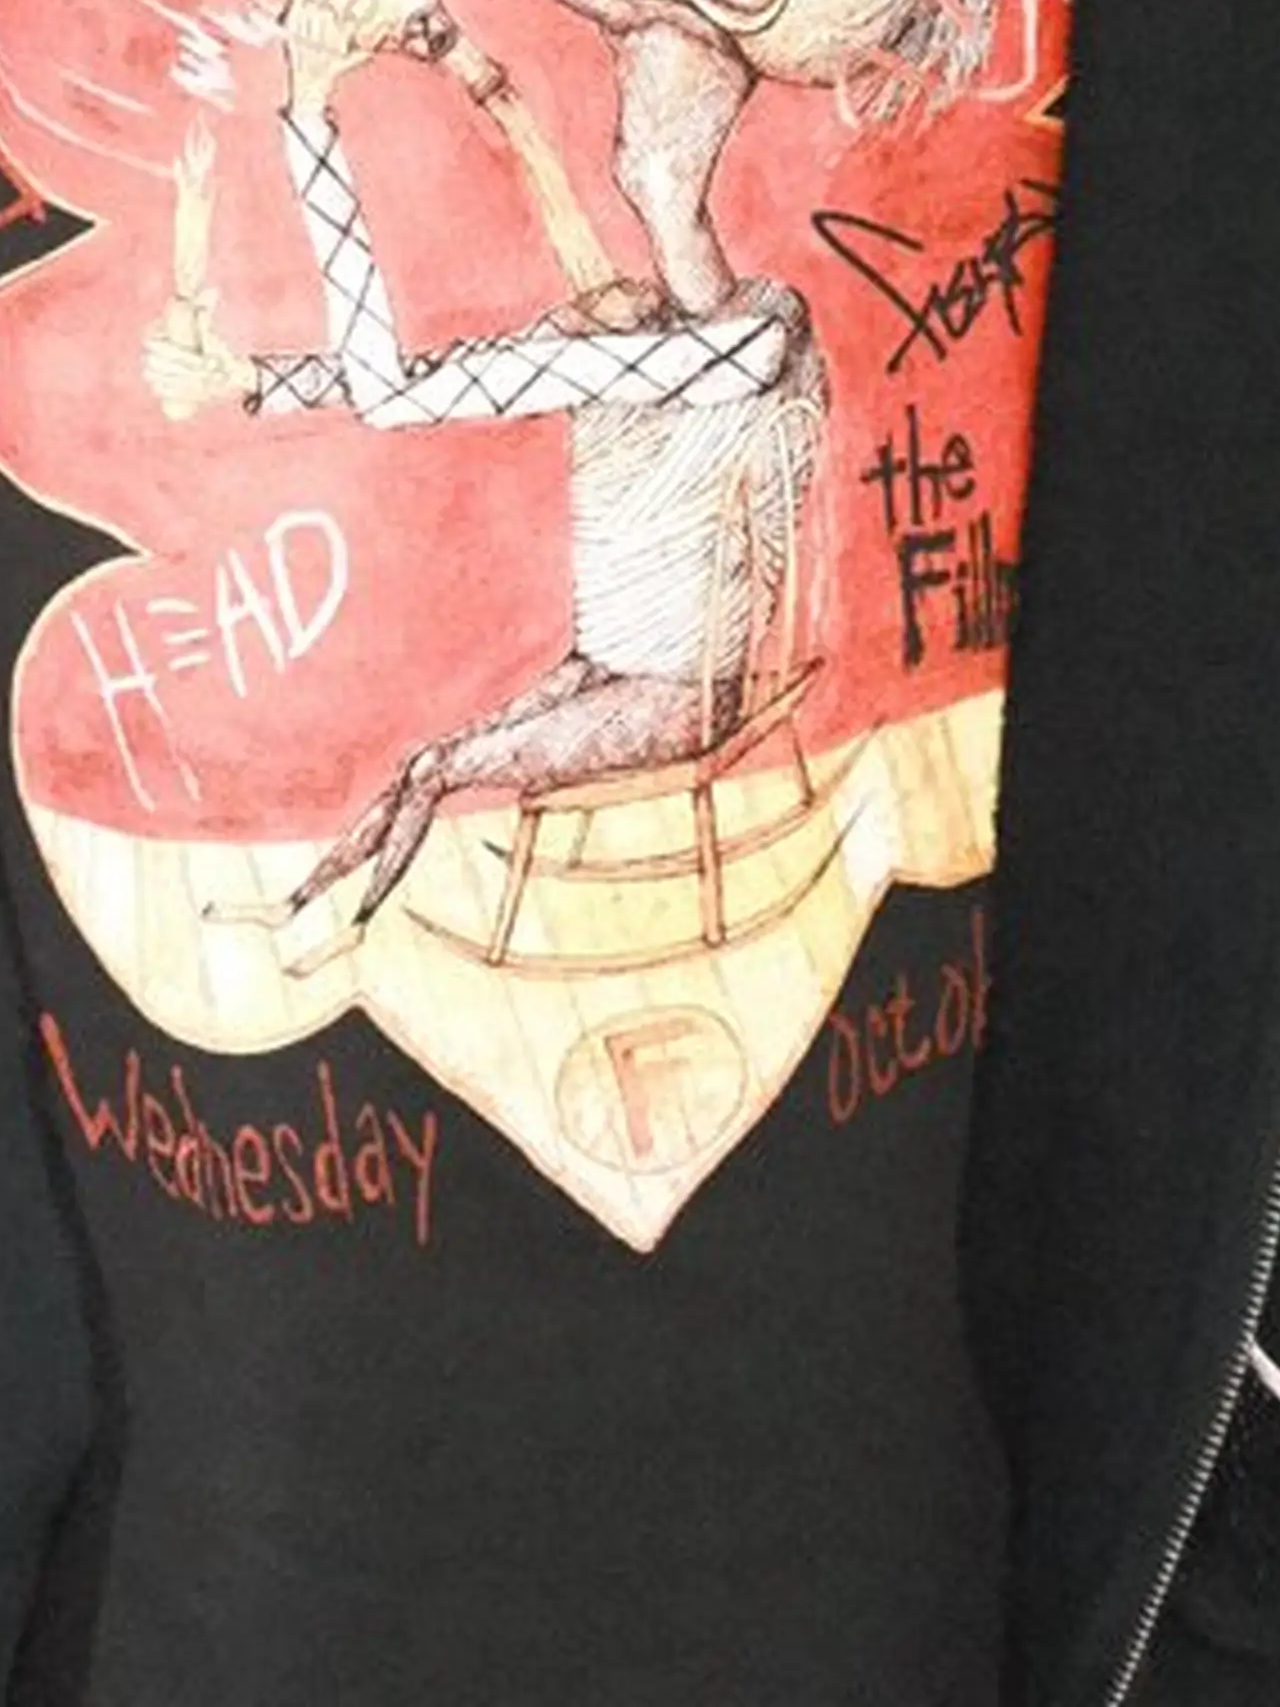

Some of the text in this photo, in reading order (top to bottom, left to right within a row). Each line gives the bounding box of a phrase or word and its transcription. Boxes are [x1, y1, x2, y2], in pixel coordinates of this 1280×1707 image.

[858, 403, 976, 532] the
[70, 509, 350, 813] HEAD
[895, 509, 1022, 669] Fill
[38, 1010, 440, 1247] Wednesday
[604, 1015, 703, 1159] F
